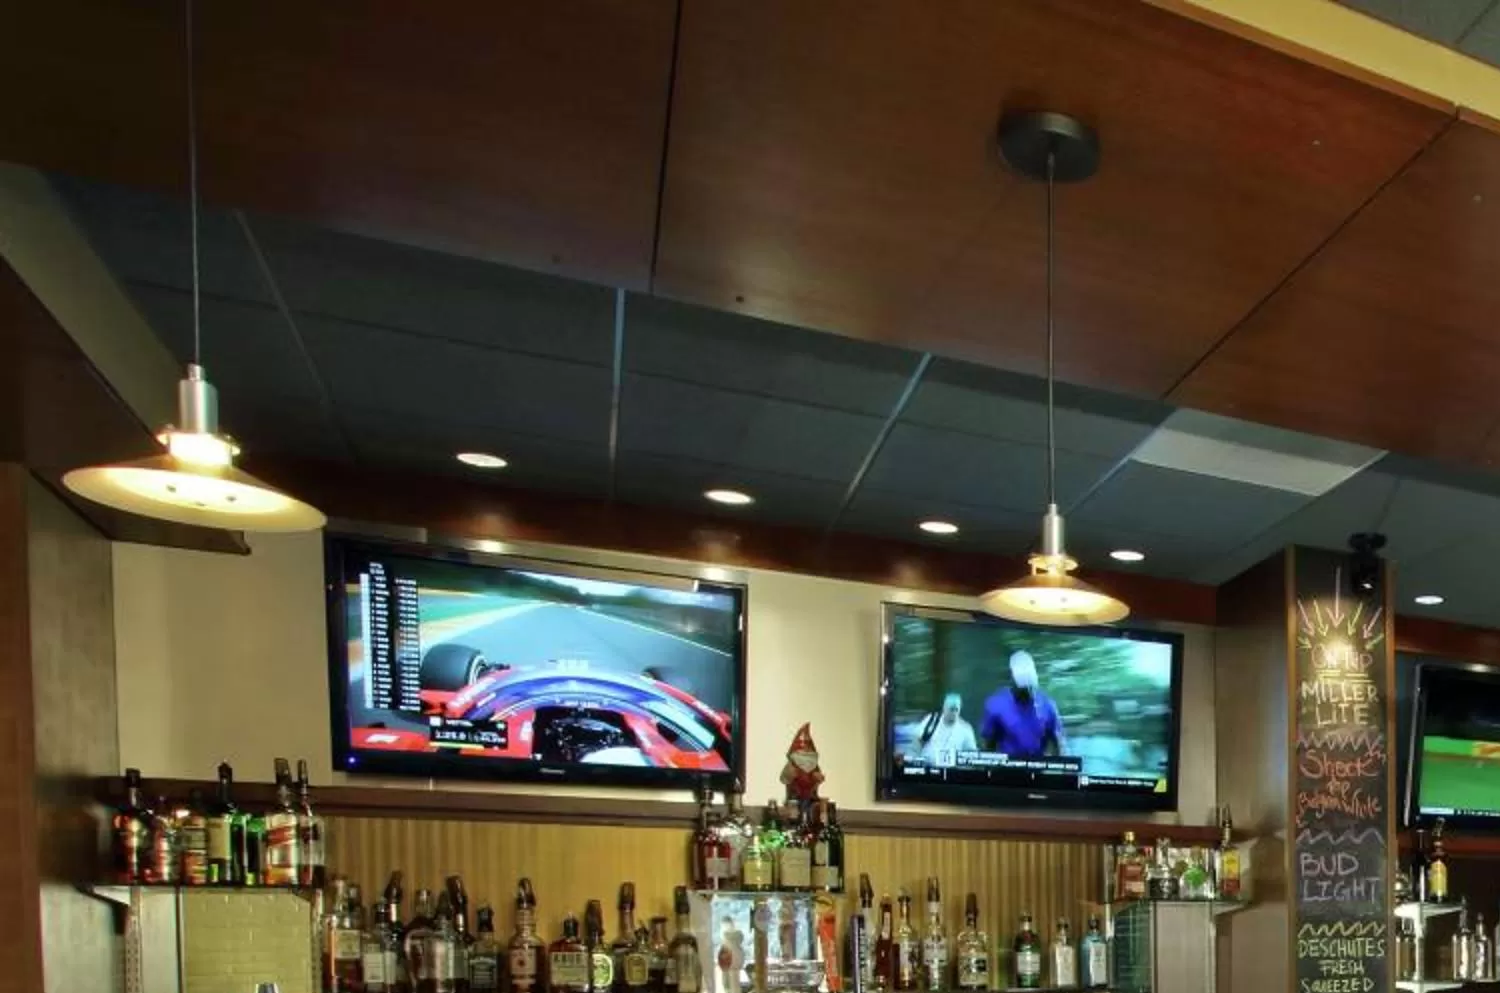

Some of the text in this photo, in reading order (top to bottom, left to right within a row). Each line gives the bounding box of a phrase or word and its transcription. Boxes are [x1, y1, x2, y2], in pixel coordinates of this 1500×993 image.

[1301, 680, 1380, 704] MILLER
[1315, 702, 1370, 729] LITE
[1300, 851, 1360, 877] BUD
[1302, 876, 1381, 905] LIGHT
[1297, 937, 1386, 959] DESCHUTES
[1317, 958, 1366, 977] FRESH
